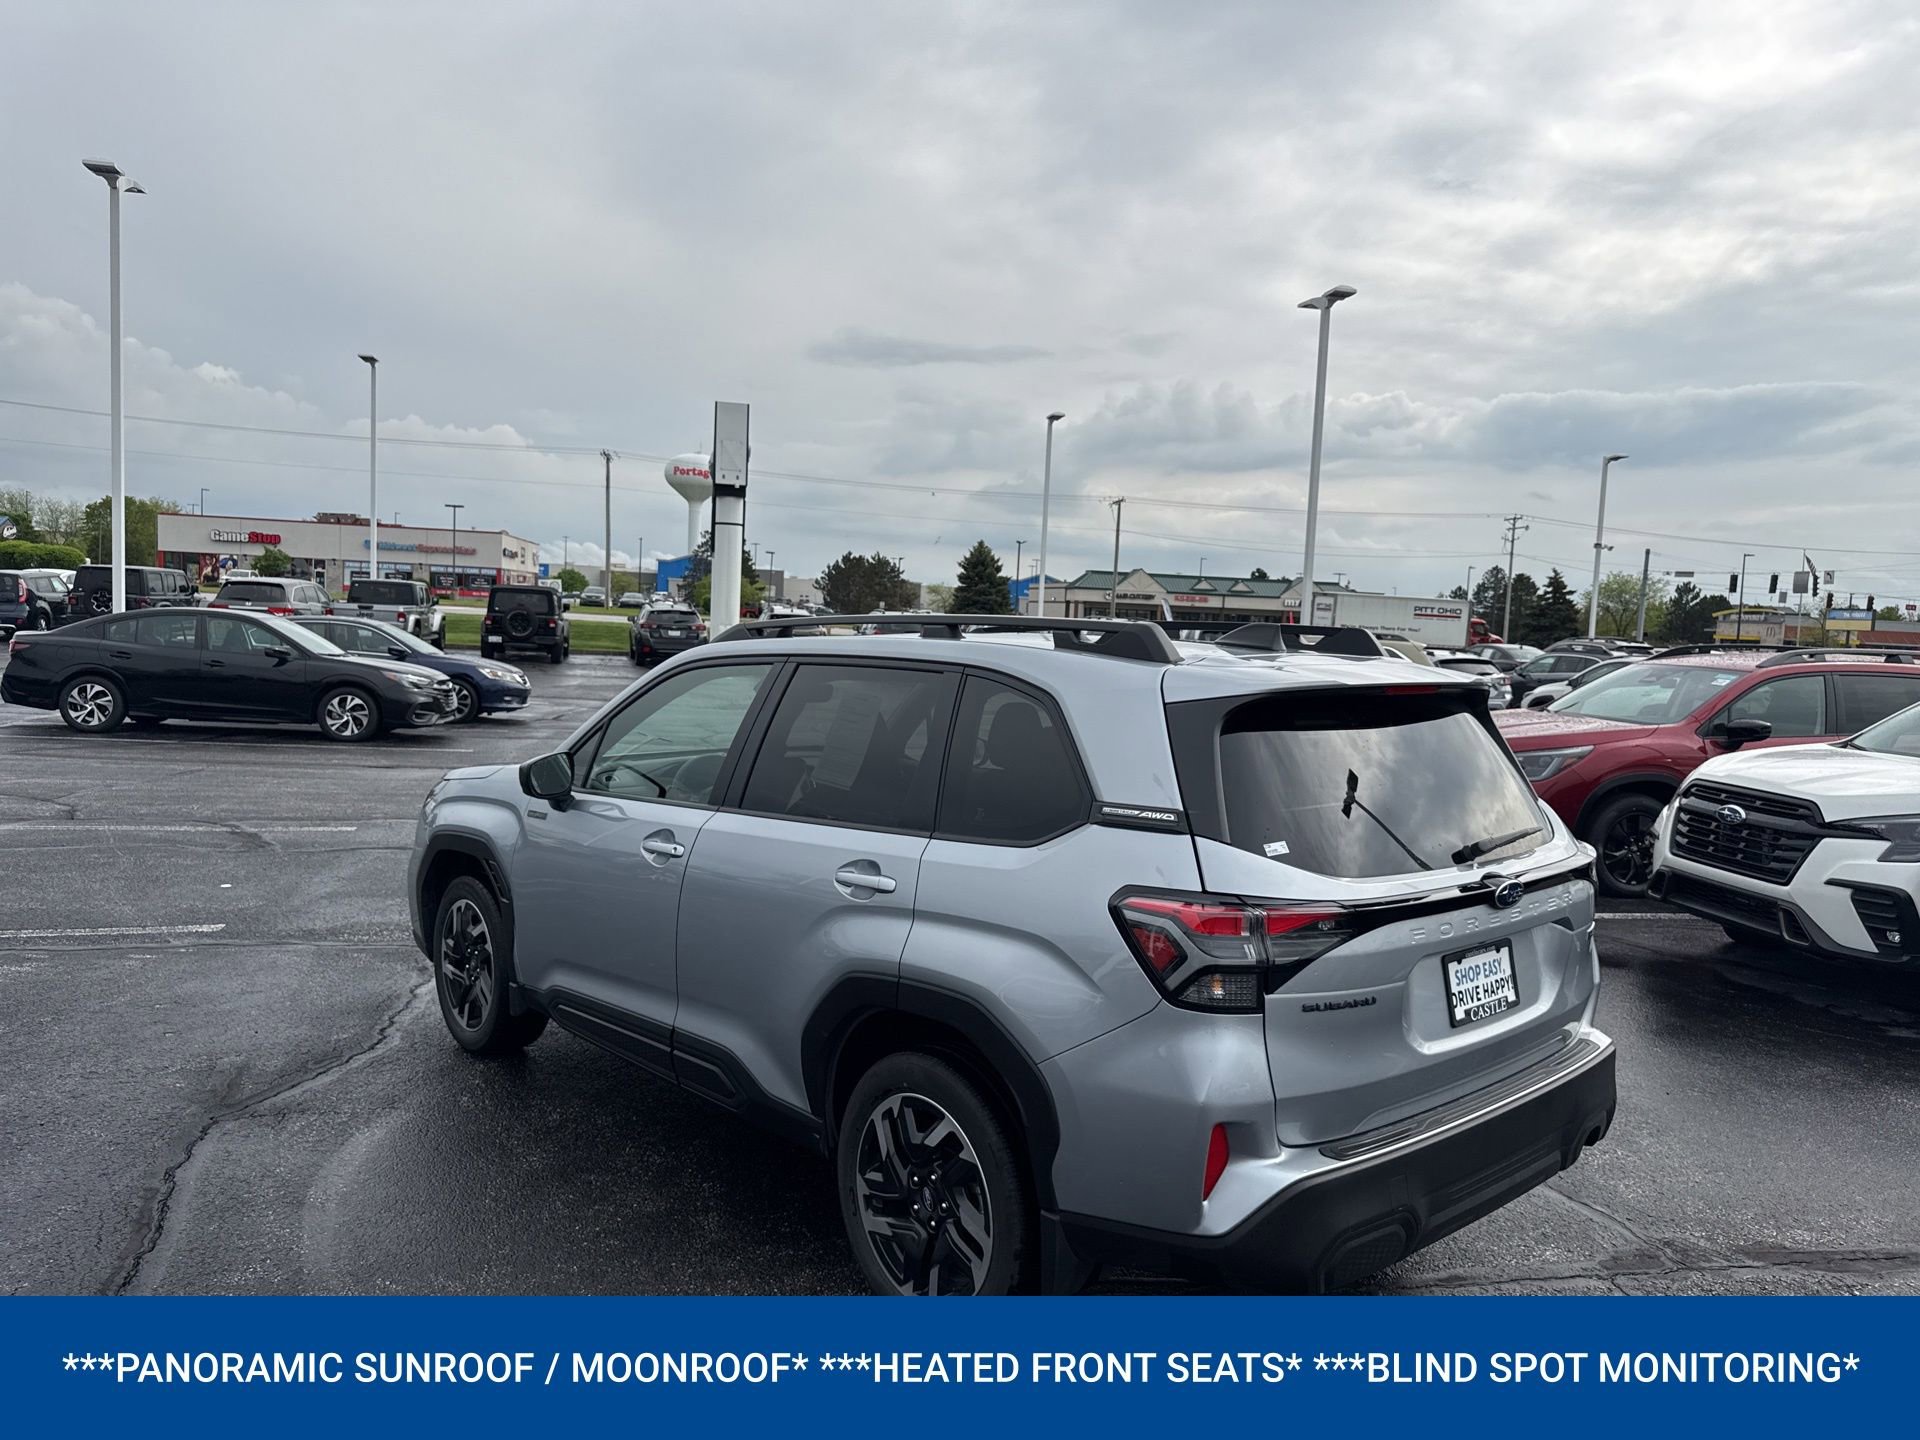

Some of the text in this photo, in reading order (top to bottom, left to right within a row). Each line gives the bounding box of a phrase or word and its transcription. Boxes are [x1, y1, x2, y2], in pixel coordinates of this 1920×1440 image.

[673, 466, 711, 479] Portag
[210, 529, 281, 545] GameStop
[1437, 607, 1462, 615] OHIO
[1138, 811, 1176, 820] AWD
[1409, 890, 1573, 944] FORESTER
[1454, 957, 1506, 986] SHOP EASY,
[1452, 974, 1515, 1009] DRIVE HAPPY!
[1301, 996, 1377, 1012] SUBARU
[1470, 998, 1508, 1021] CASTLE
